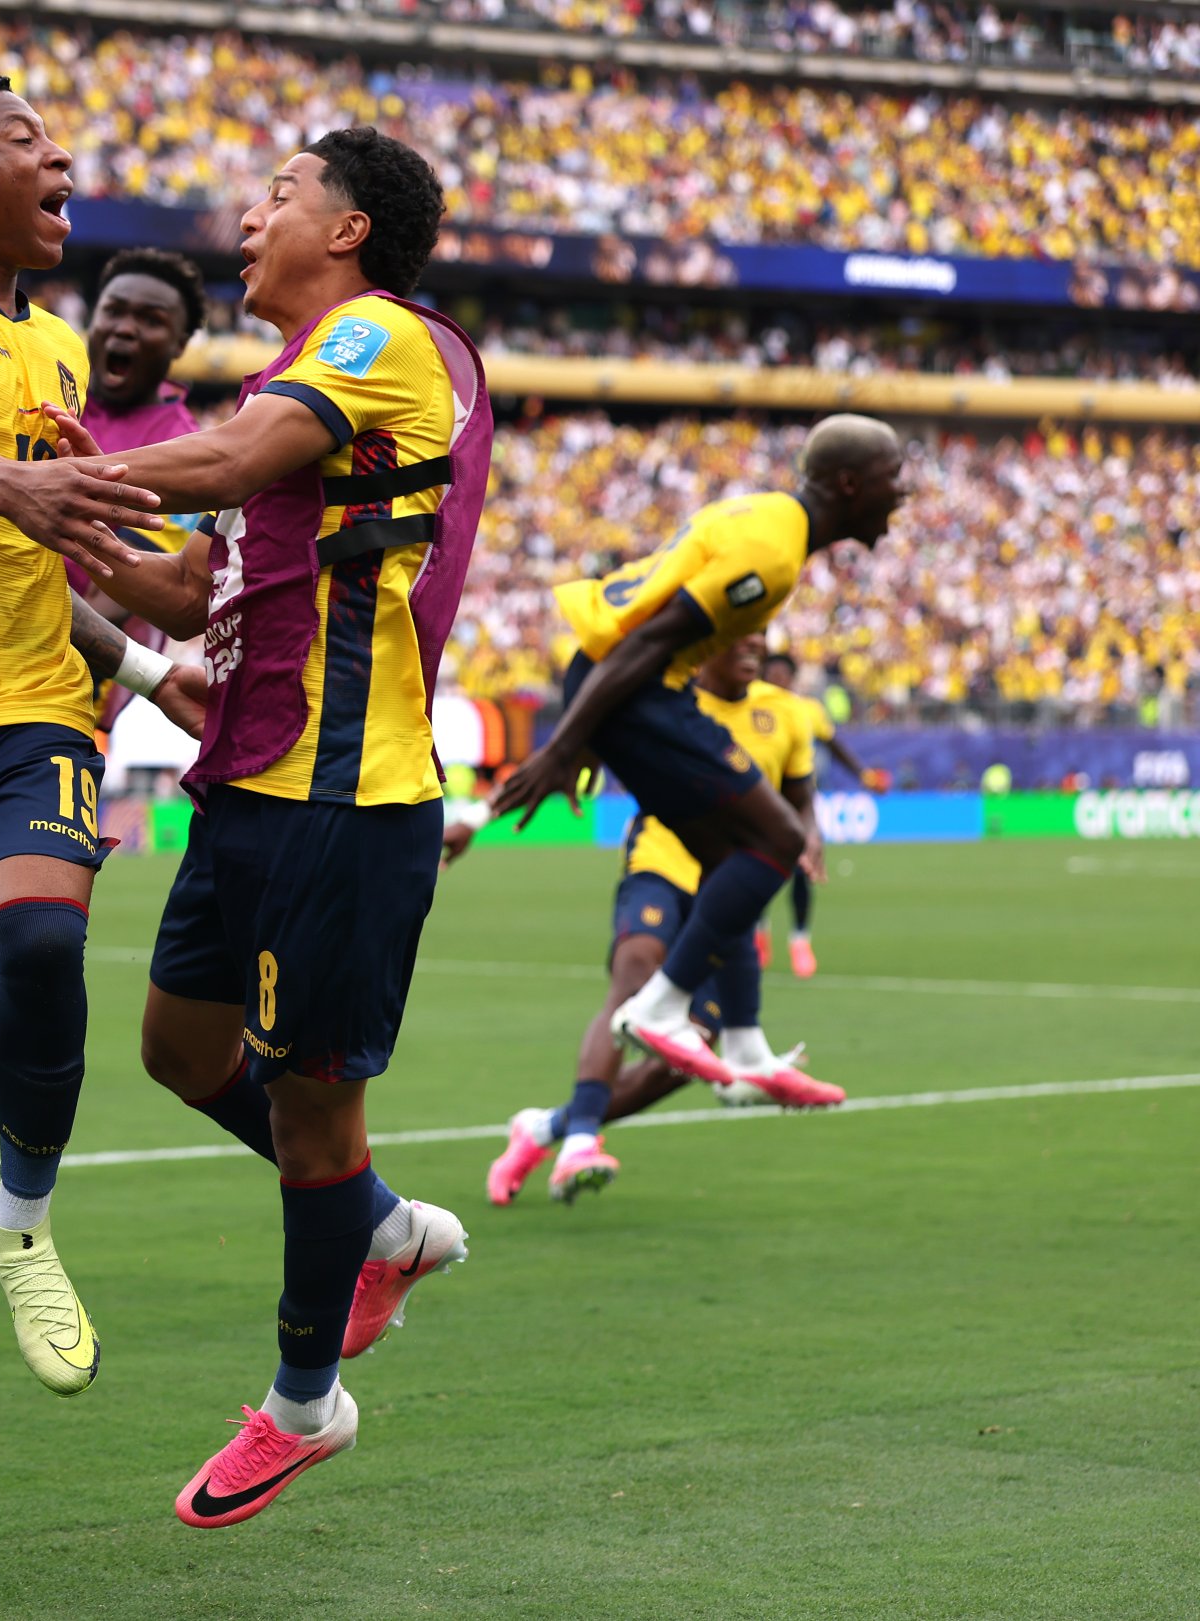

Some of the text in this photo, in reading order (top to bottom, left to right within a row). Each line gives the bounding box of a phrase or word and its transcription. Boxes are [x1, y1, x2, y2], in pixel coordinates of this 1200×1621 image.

[50, 755, 99, 840] 19
[29, 820, 97, 856] maratho
[258, 950, 279, 1031] 8
[2, 1123, 69, 1155] maratho
